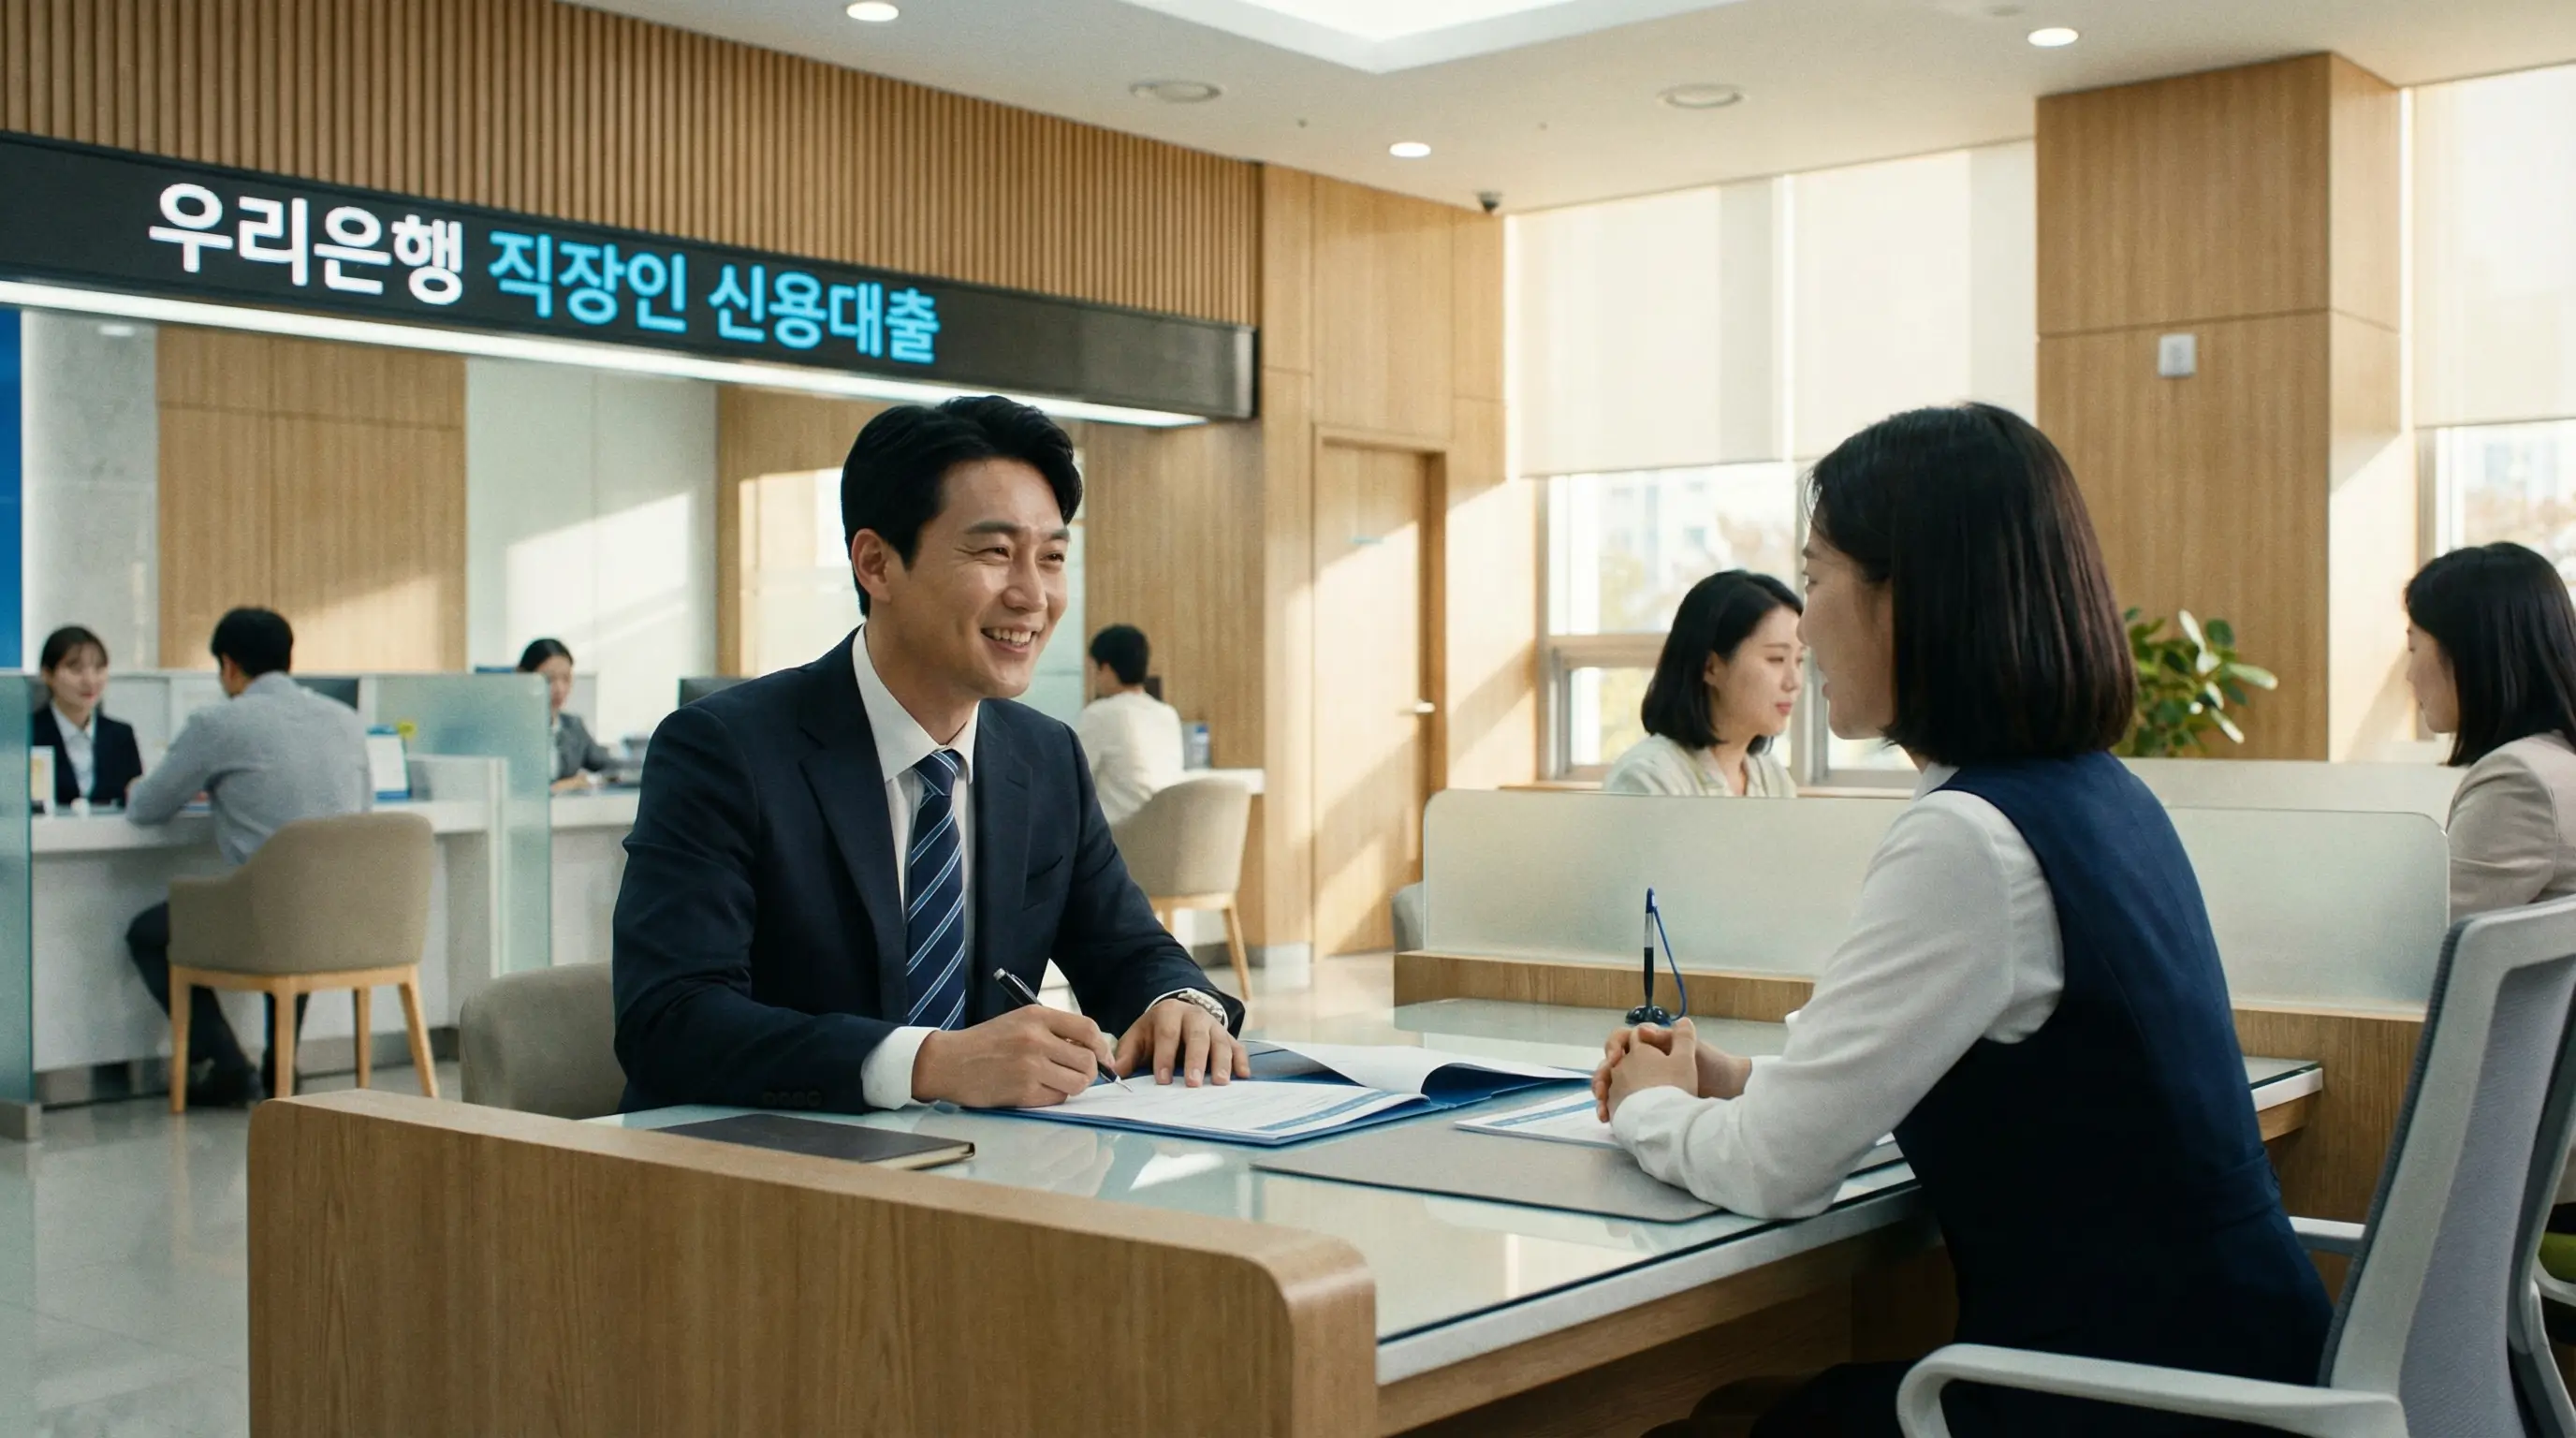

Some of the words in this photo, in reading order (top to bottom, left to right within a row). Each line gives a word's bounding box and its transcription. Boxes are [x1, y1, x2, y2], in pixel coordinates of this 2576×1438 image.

[149, 183, 463, 306] 우리은행
[488, 230, 687, 333] 직장인
[708, 264, 941, 364] 신용대출
